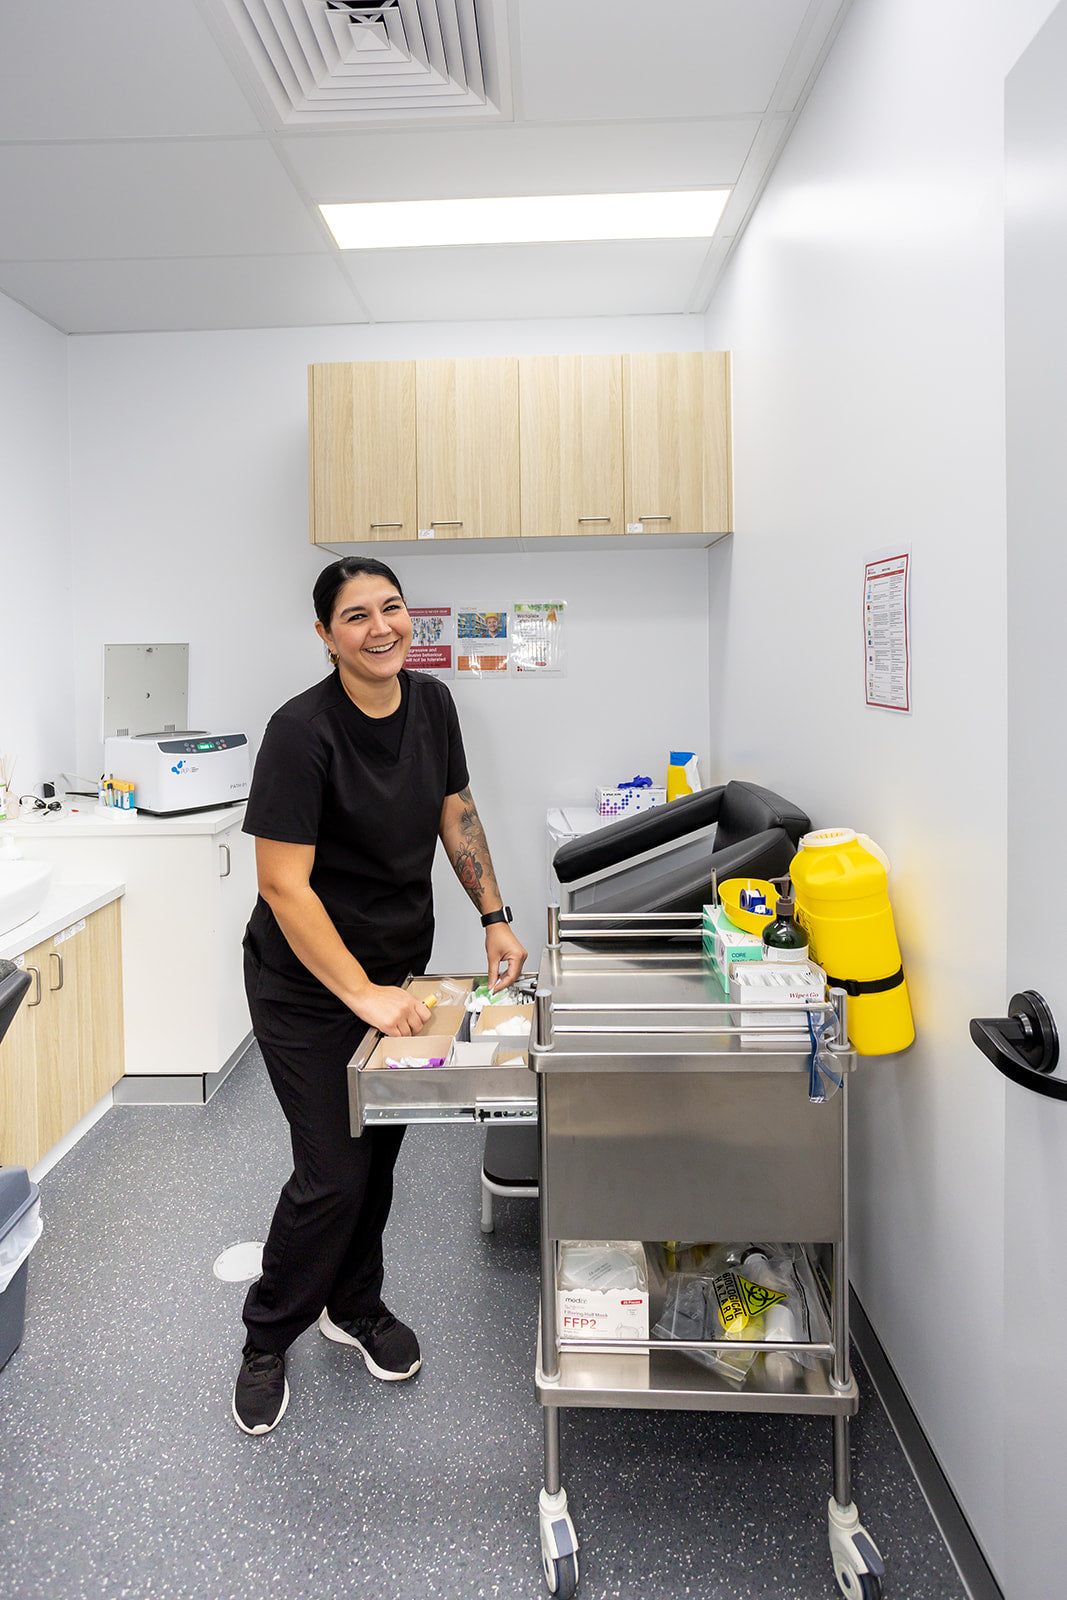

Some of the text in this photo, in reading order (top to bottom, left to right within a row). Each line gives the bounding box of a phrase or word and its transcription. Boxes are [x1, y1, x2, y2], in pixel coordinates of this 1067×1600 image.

[714, 1276, 734, 1322] HAZARD
[722, 1272, 743, 1319] BIOLOGICAL
[563, 1316, 597, 1330] FFP2
